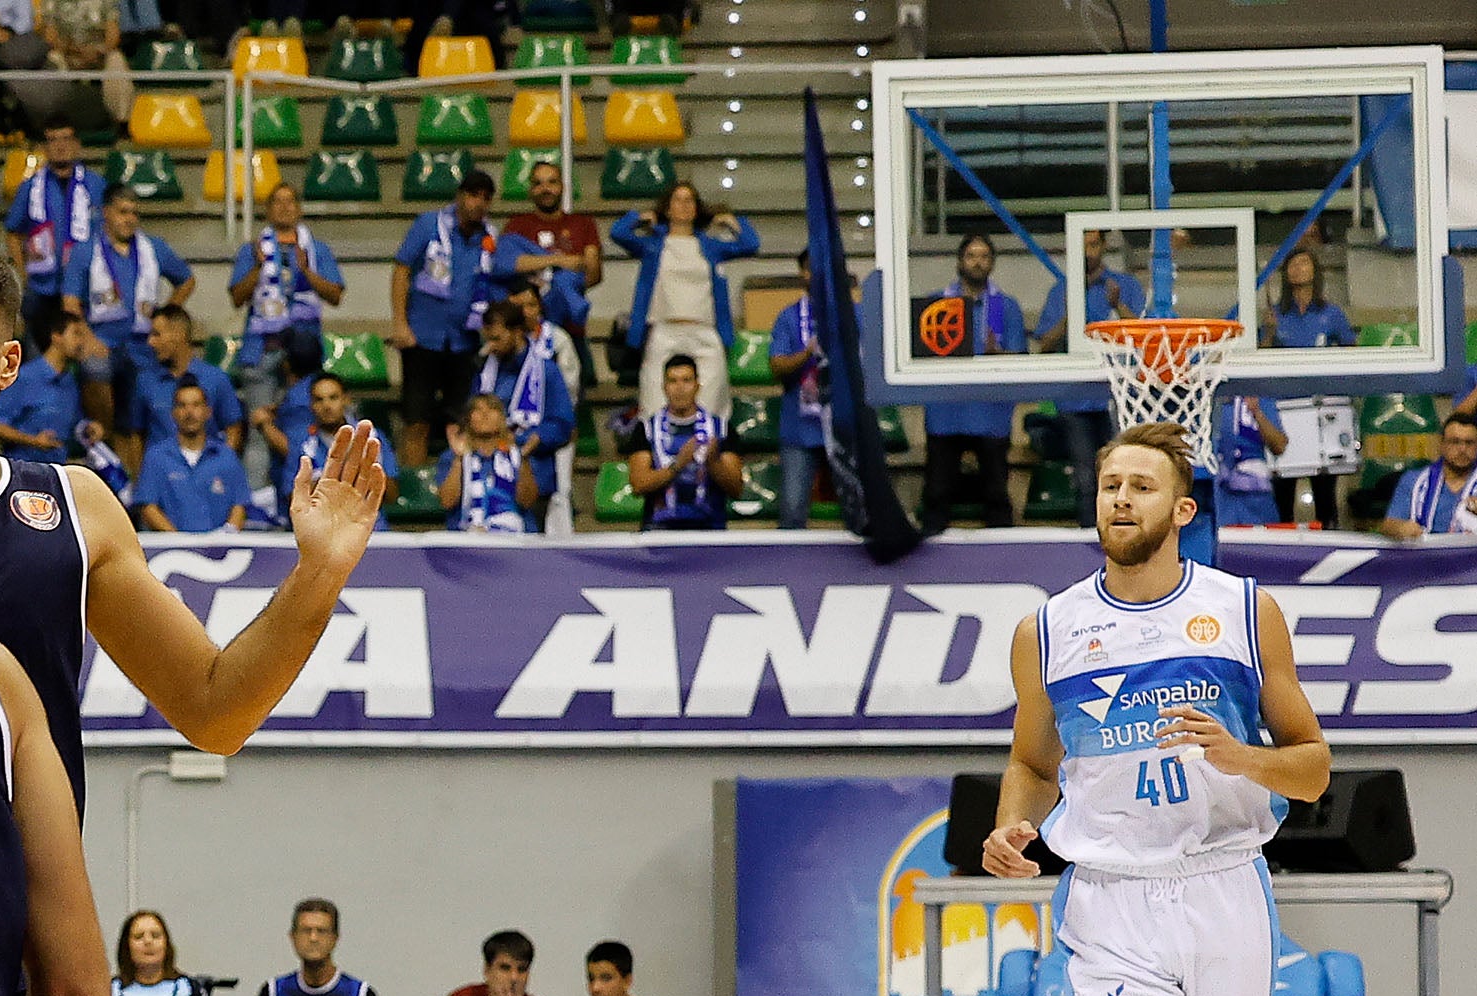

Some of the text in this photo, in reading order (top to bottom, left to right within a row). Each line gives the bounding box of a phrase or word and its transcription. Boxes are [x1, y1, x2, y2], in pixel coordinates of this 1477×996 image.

[79, 548, 1477, 719] ÑA ANDÉS
[1072, 621, 1117, 638] GIVOVA
[1100, 716, 1196, 749] BURG
[1136, 755, 1190, 807] 40
